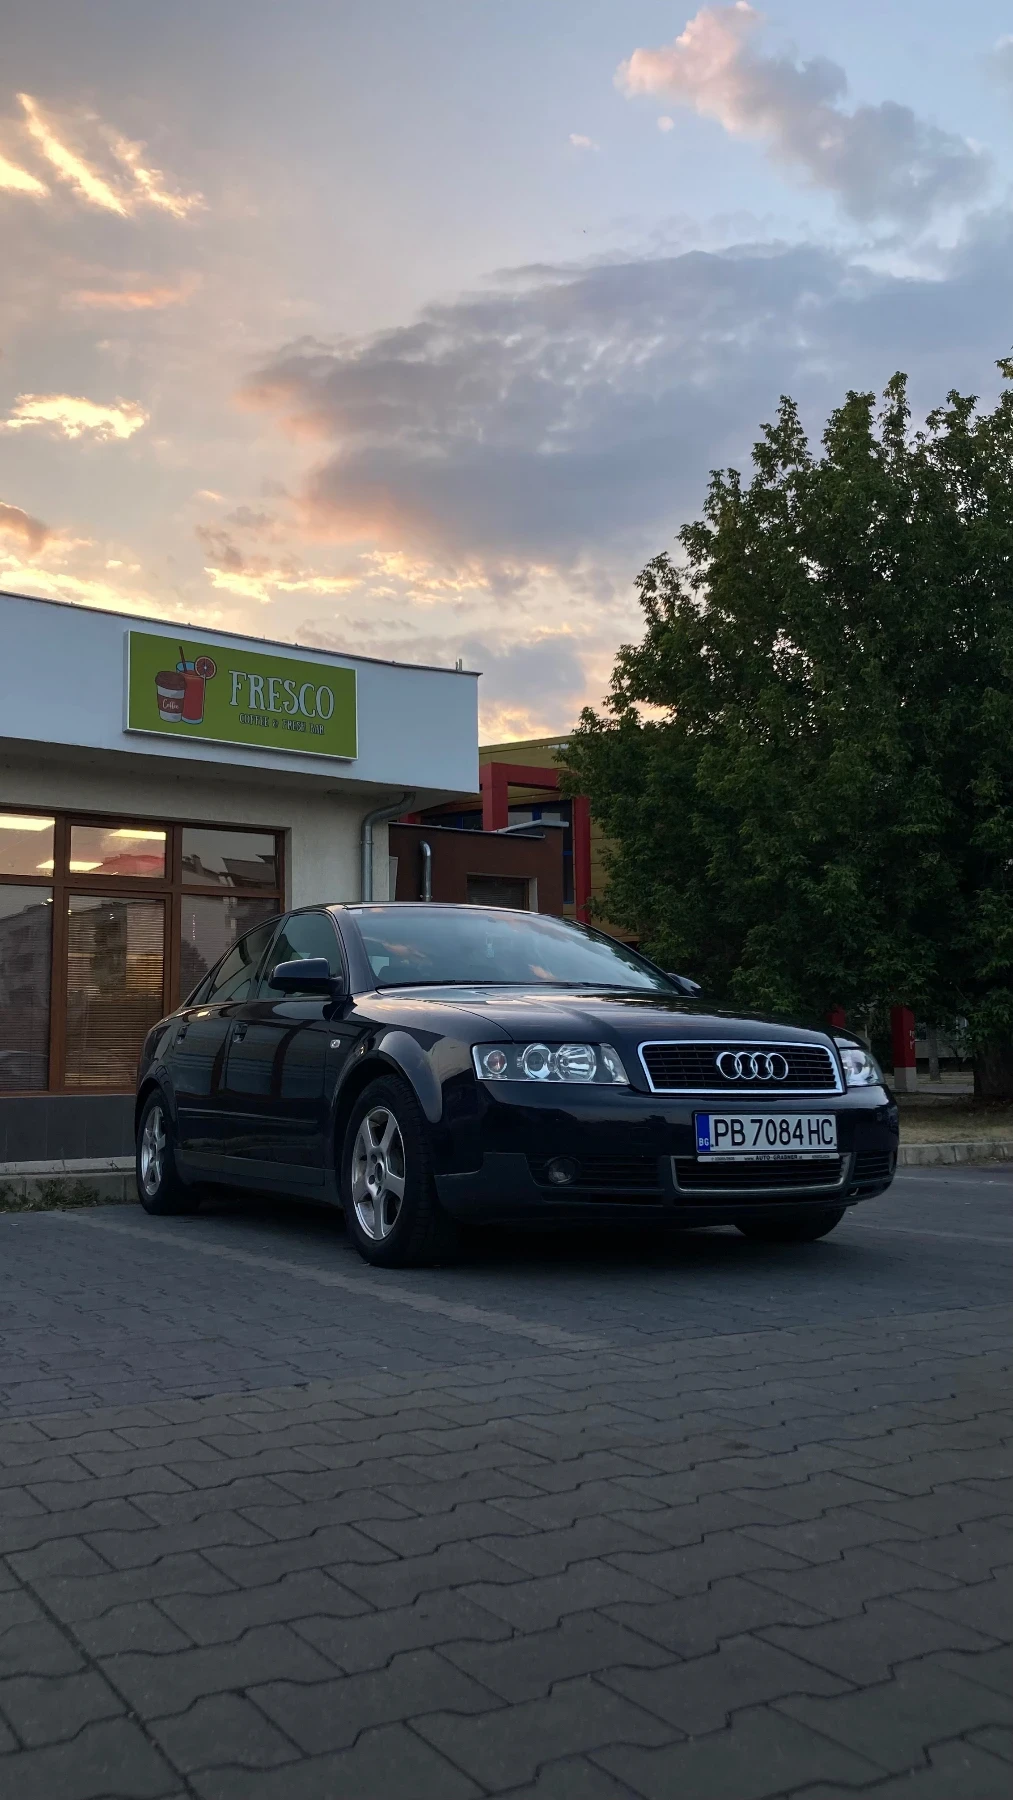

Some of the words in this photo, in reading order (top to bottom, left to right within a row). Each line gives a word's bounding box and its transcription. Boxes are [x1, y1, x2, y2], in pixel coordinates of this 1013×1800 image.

[228, 670, 335, 720] FRESCO
[162, 698, 180, 710] Coffee
[239, 713, 269, 728] COFFEE
[282, 720, 306, 733] FRESH
[698, 1138, 710, 1147] BG
